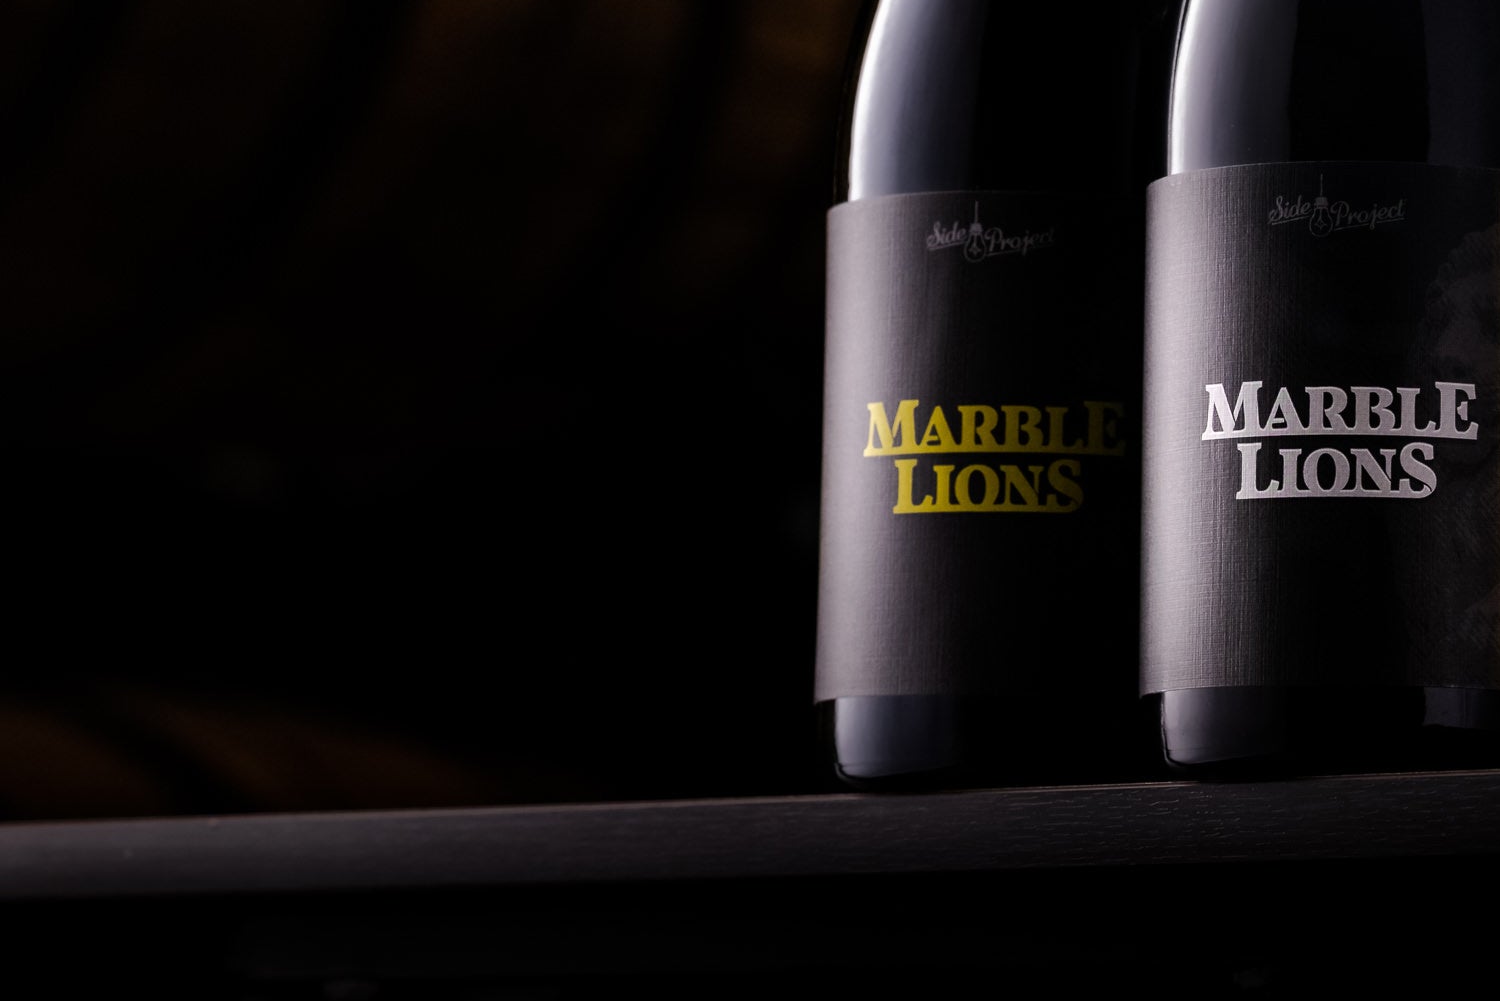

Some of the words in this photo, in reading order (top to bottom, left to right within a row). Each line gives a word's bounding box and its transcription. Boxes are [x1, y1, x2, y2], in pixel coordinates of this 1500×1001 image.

[926, 220, 967, 250] Side
[985, 226, 1057, 257] Project
[1268, 195, 1312, 225] Side
[1330, 199, 1407, 231] Project
[864, 399, 1126, 457] MARBLE
[1201, 380, 1480, 441] MARBLE
[892, 458, 1085, 515] LIONS
[1235, 442, 1438, 500] LIONS
